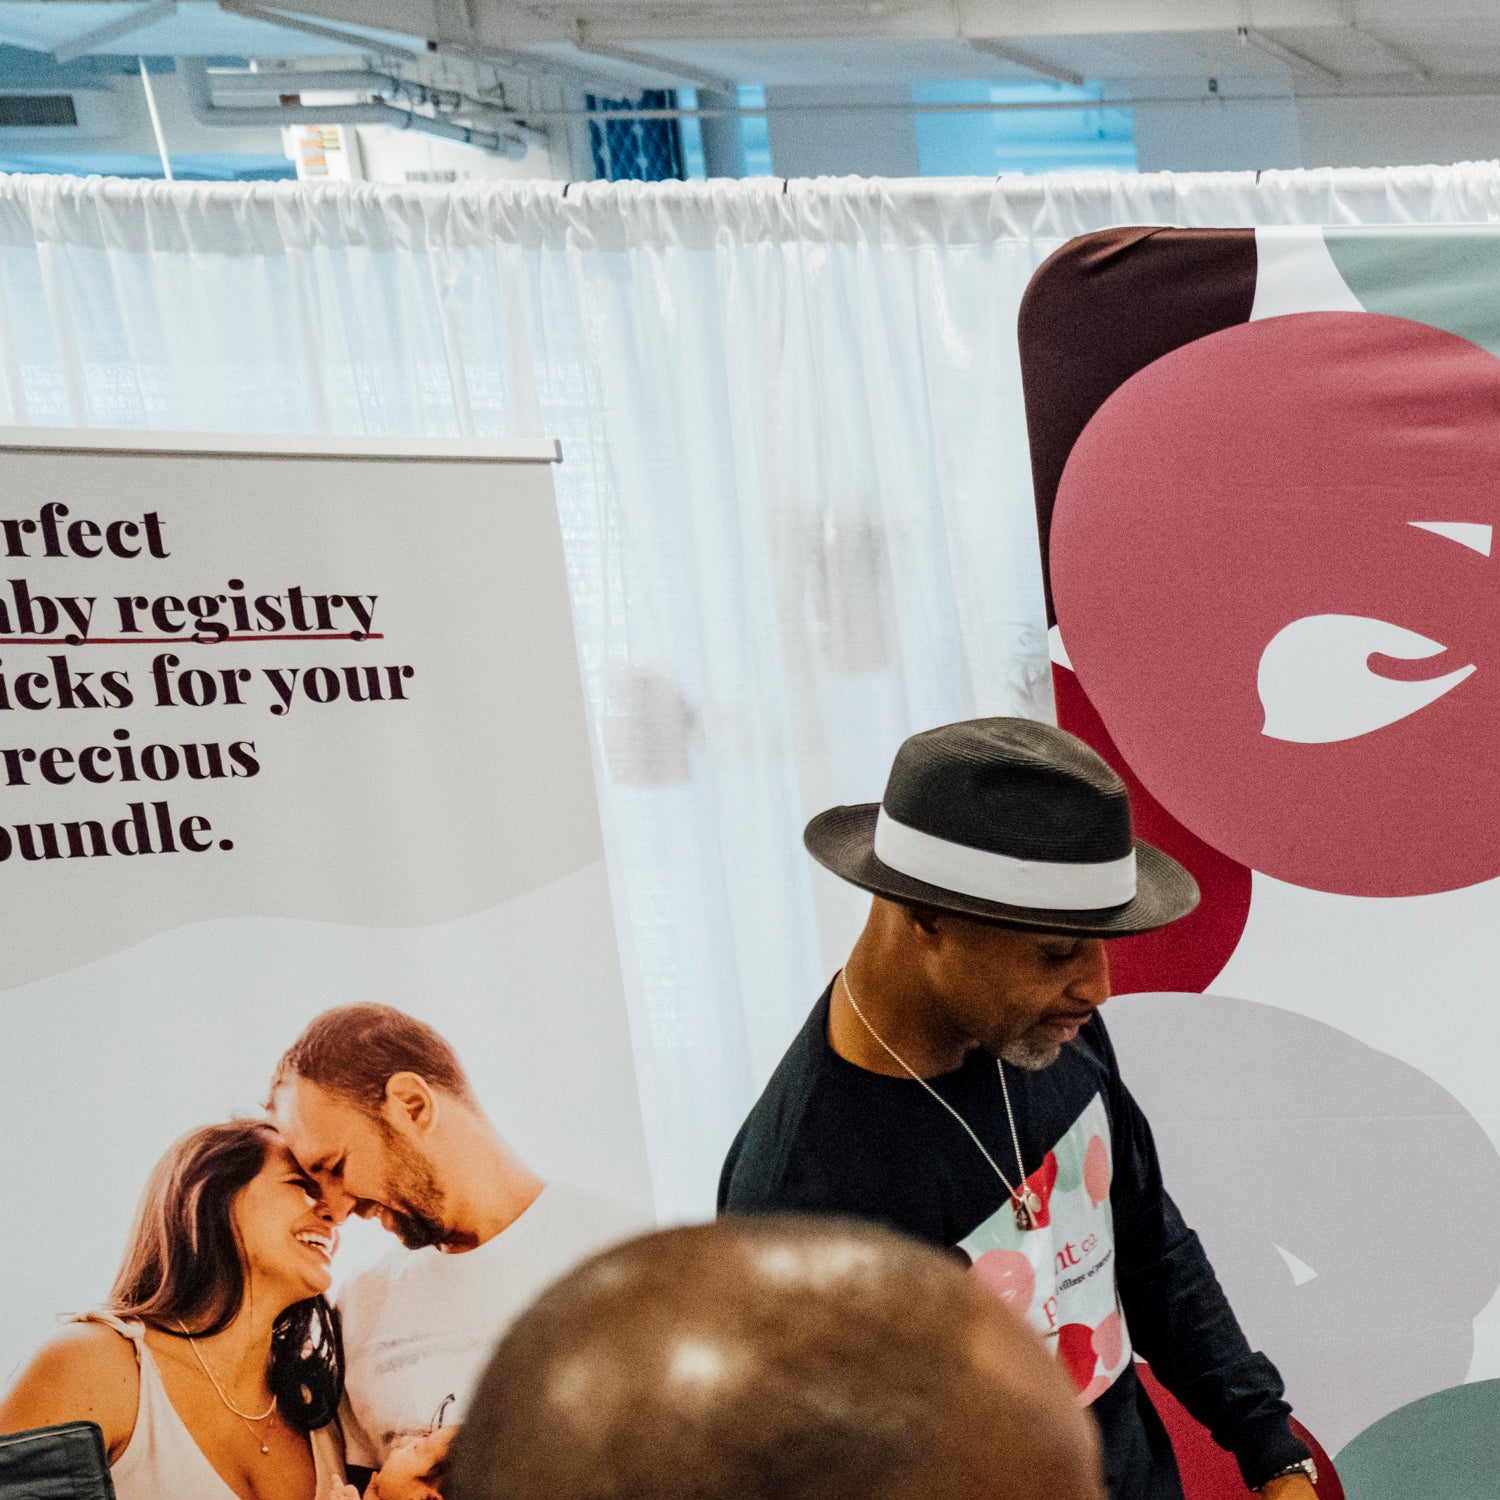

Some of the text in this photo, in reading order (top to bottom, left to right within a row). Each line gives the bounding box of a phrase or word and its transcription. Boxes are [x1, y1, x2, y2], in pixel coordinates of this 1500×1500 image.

[115, 578, 378, 644] registry
[149, 653, 251, 707] for
[261, 662, 415, 716] your
[0, 729, 261, 787] recious
